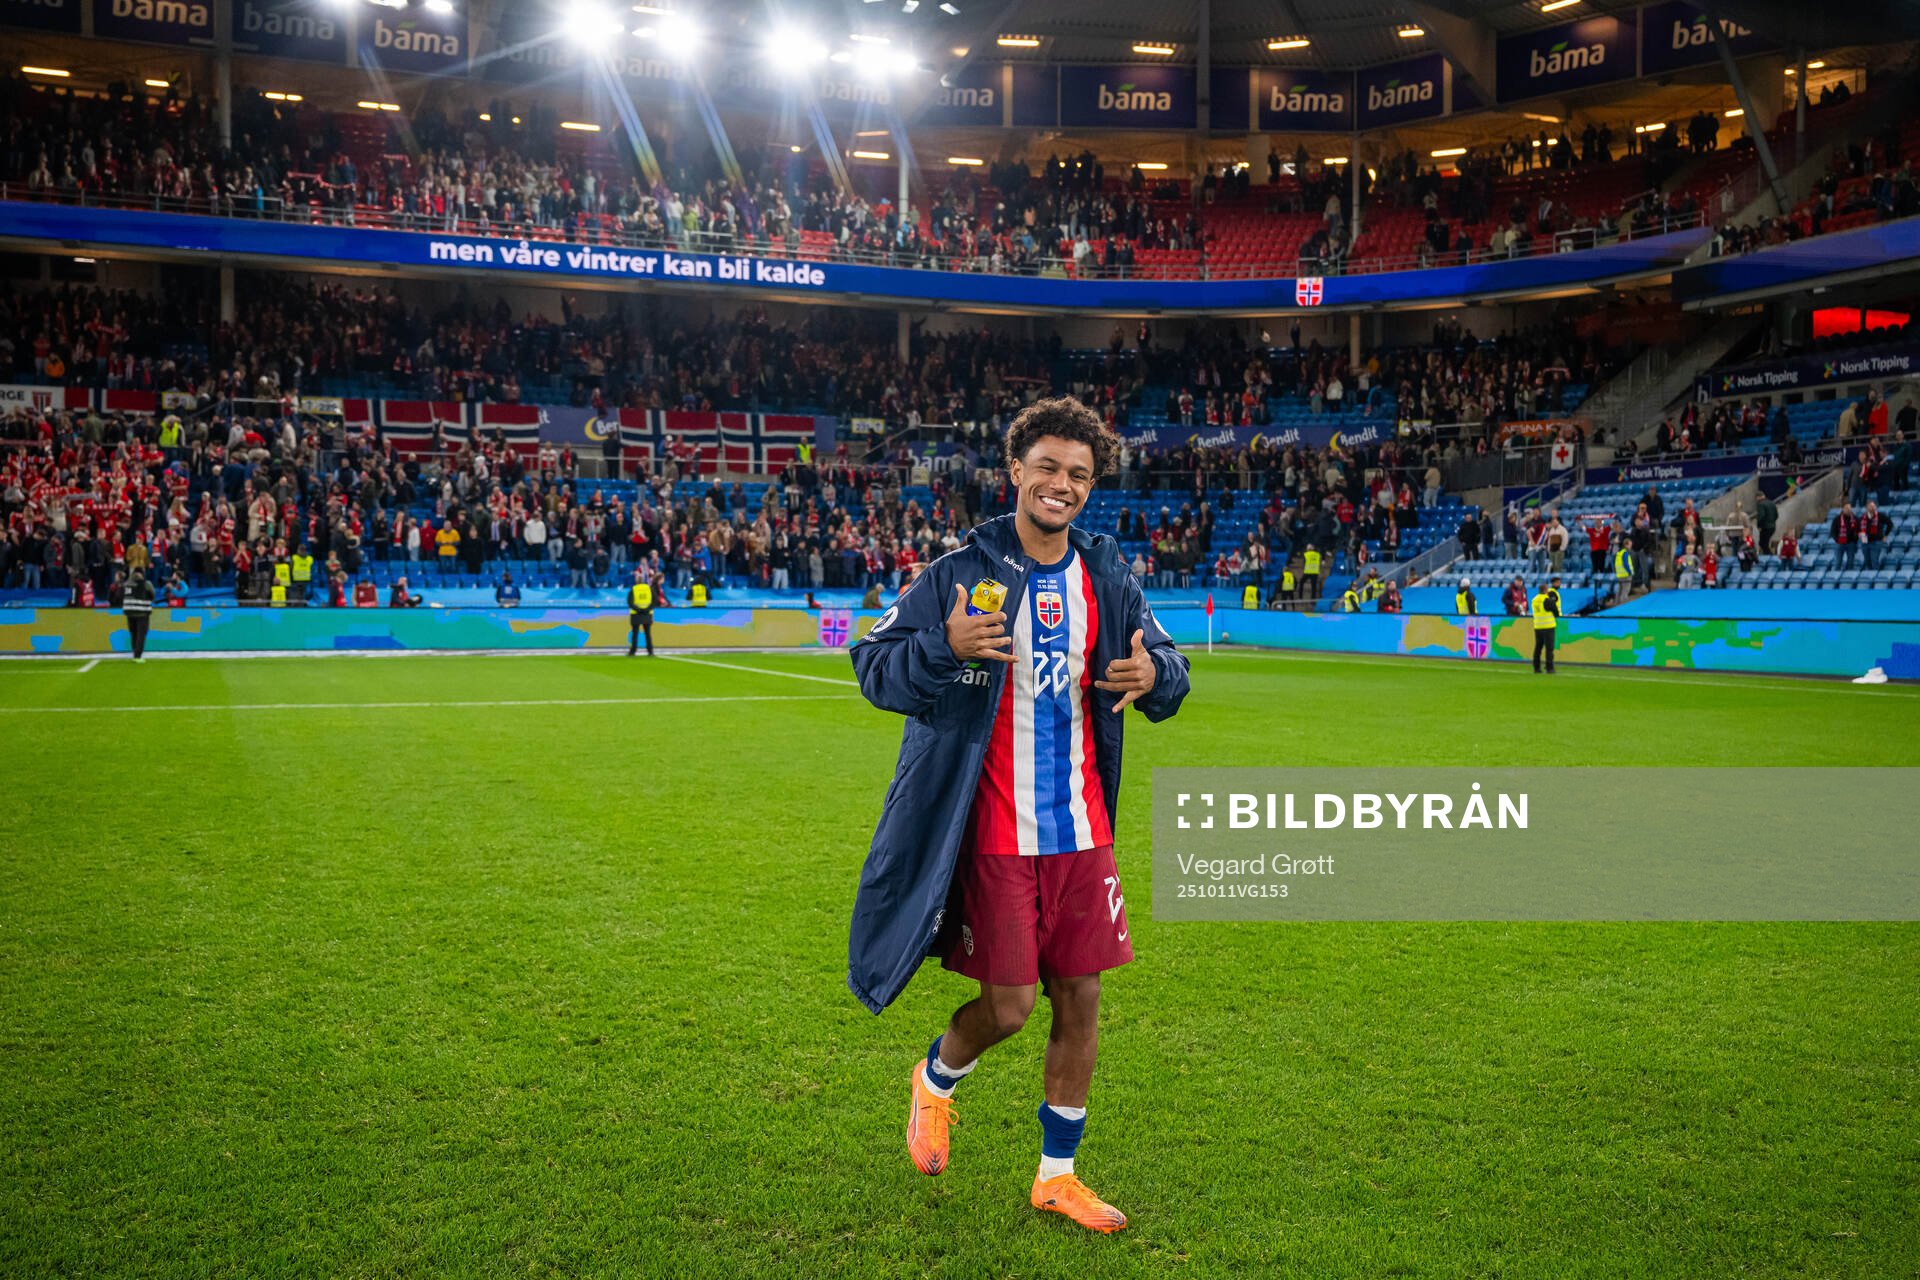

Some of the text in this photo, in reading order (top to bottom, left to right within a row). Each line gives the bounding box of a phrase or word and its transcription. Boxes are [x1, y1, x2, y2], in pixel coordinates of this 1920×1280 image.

[430, 241, 826, 286] men våre vintrer kan bli kalde
[1840, 355, 1910, 375] Norsk Tipping
[1737, 371, 1799, 387] Norsk Tipping
[907, 448, 950, 472] bam
[1630, 465, 1684, 479] Norsk Tipping
[1033, 651, 1069, 698] 22
[1104, 873, 1124, 924] 2
